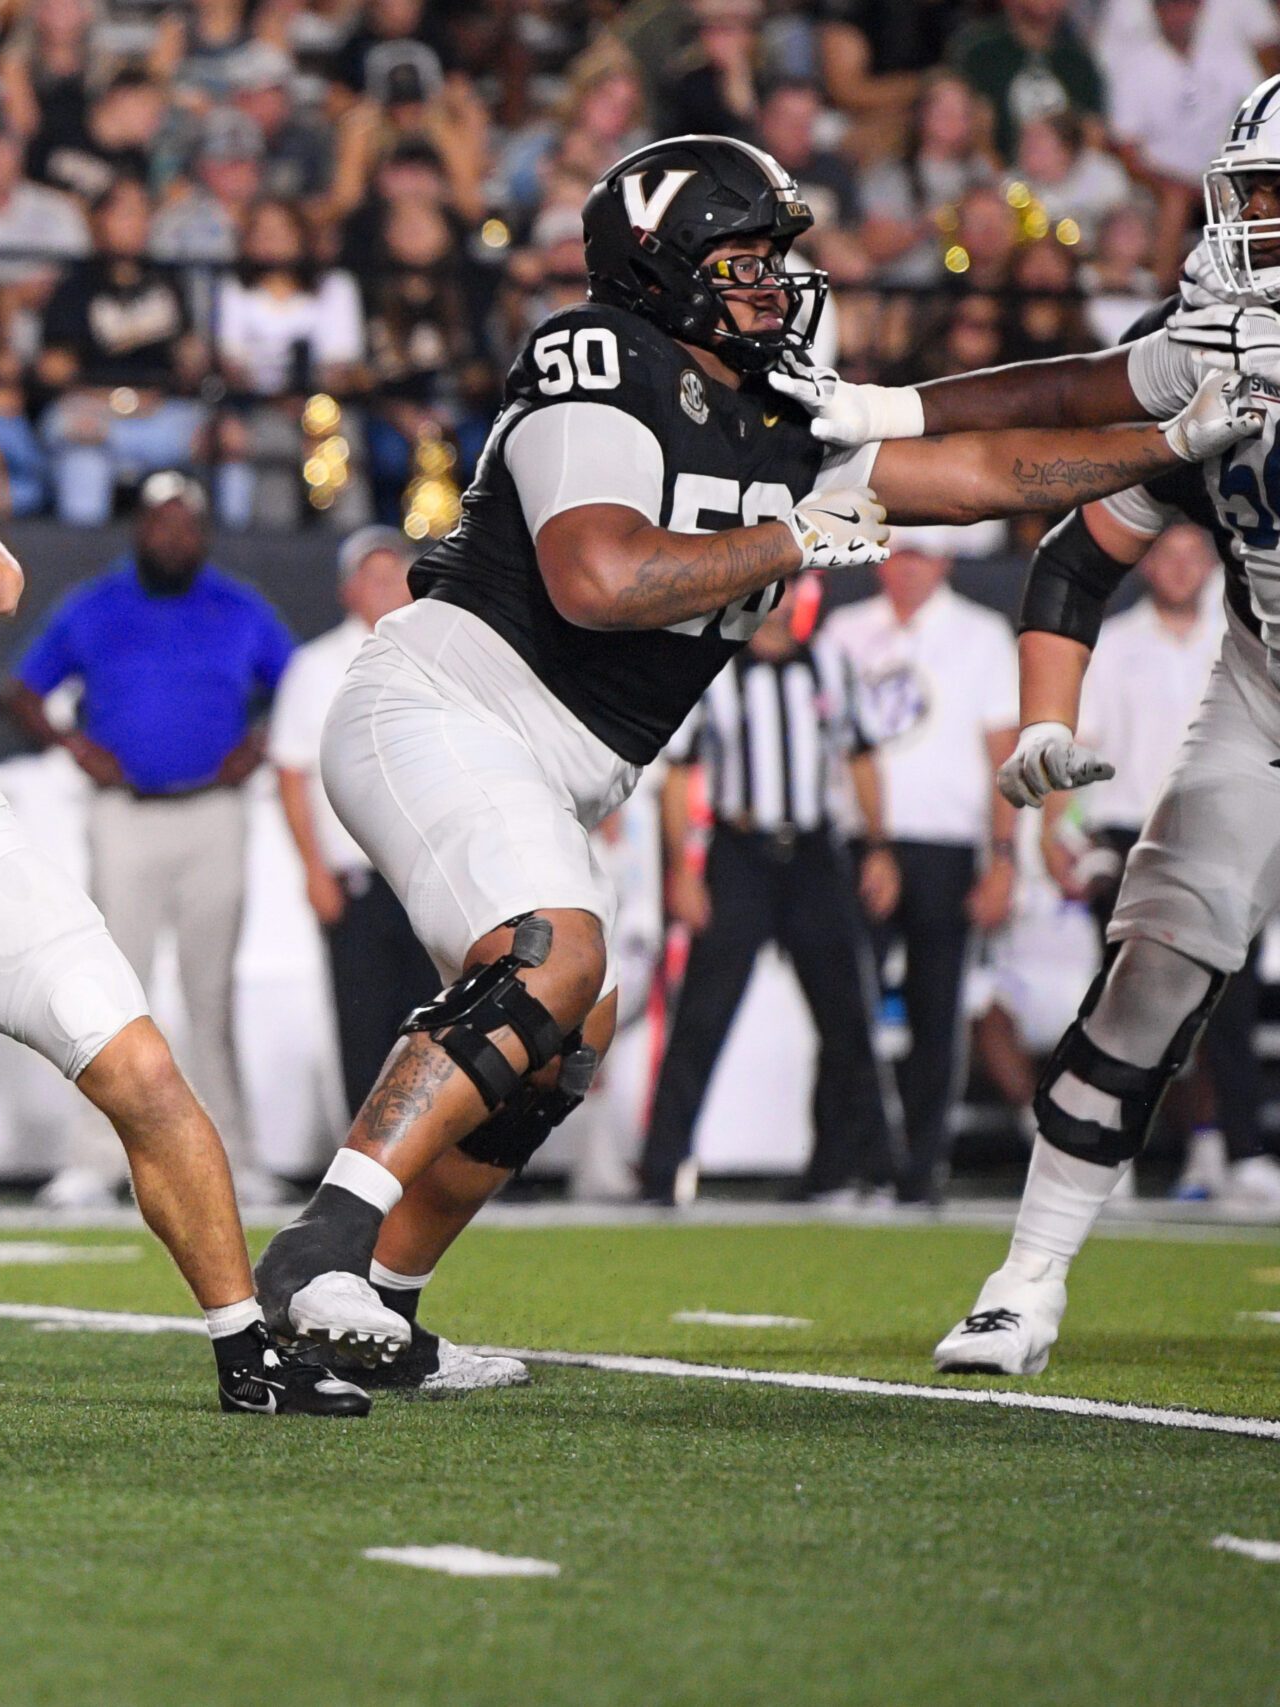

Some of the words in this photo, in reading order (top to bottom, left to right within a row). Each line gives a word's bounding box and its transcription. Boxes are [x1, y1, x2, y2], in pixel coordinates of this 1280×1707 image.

[622, 170, 698, 232] V
[534, 327, 621, 395] 50
[663, 472, 794, 641] 50
